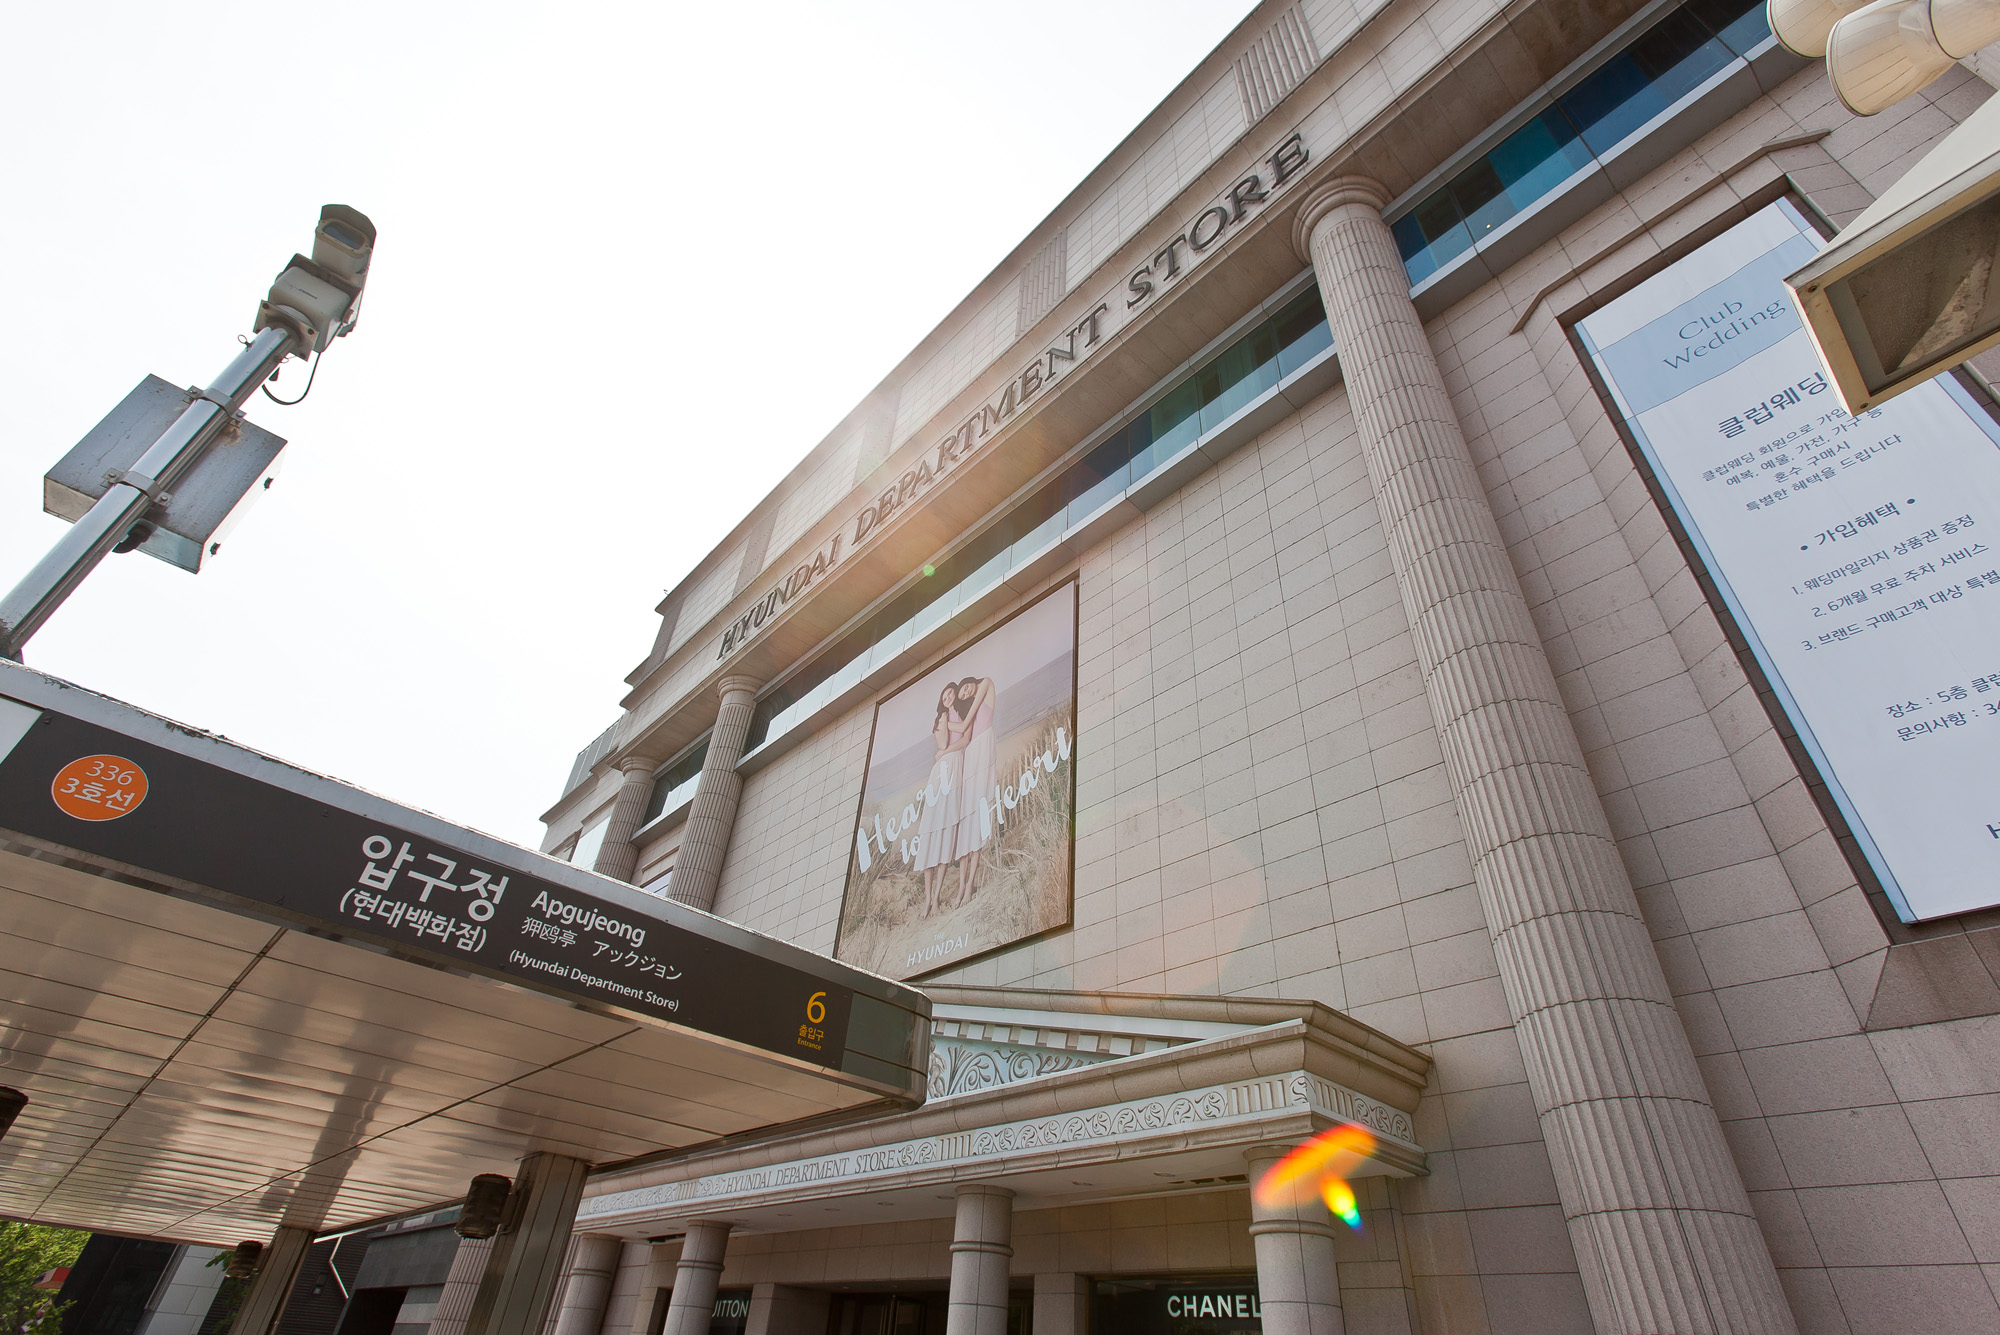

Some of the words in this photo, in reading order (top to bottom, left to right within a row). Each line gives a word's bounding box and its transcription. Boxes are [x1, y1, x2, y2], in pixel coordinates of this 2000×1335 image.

[1662, 299, 1786, 371] Wedding
[1678, 299, 1743, 341] Club
[716, 533, 841, 661] HYUNDAI
[851, 302, 1107, 546] DEPARTMENT
[1126, 132, 1309, 310] STORE
[1718, 372, 1828, 439] 클럽웨딩
[1832, 416, 1862, 436] 가구
[1702, 452, 1755, 481] 클럽웨딩
[1758, 424, 1814, 455] 회원으로
[1745, 488, 1789, 512] 특별한
[1791, 466, 1837, 491] 혜택을
[1840, 434, 1902, 470] 드립니다
[1774, 466, 1803, 483] 혼수
[1806, 440, 1851, 466] 구매시
[1814, 501, 1901, 546] 가입혜택
[1803, 550, 1890, 591] 웨딩마일리지
[1892, 528, 1940, 556] 상품권
[1940, 514, 1975, 535] 증정
[1827, 589, 1869, 612] 6개월
[1870, 577, 1902, 596] 무료
[1903, 562, 1936, 581] 주차
[1939, 542, 1989, 568] 서비스
[1818, 623, 1864, 646] 브랜드
[1865, 598, 1928, 629] 구매고객
[1929, 584, 1963, 603] 대상
[1885, 700, 1923, 718] 장소
[1936, 685, 1968, 702] 5층
[1897, 711, 1967, 742] 문의사항
[60, 777, 135, 812] 3호선
[85, 761, 135, 786] 336
[979, 727, 1073, 842] Heart
[857, 760, 954, 874] Heart
[900, 834, 921, 864] to
[358, 835, 509, 921] 압구정
[339, 888, 487, 952] (현대백화점)
[531, 890, 646, 948] Apgujeong
[521, 917, 578, 948] 狎鸥亭
[592, 940, 682, 980] アックジョン
[906, 932, 969, 968] HYUNDAI
[509, 949, 570, 977] (Hyundai
[570, 968, 643, 1000] Department
[645, 991, 679, 1012] Store)
[798, 1024, 824, 1042] 출입구
[807, 991, 826, 1024] 6
[797, 1038, 822, 1050] Entrance
[726, 1171, 772, 1193] HYUNDAI
[775, 1157, 850, 1186] DEPARTMENT
[854, 1150, 896, 1174] STORE
[1167, 1294, 1261, 1318] CHANEL
